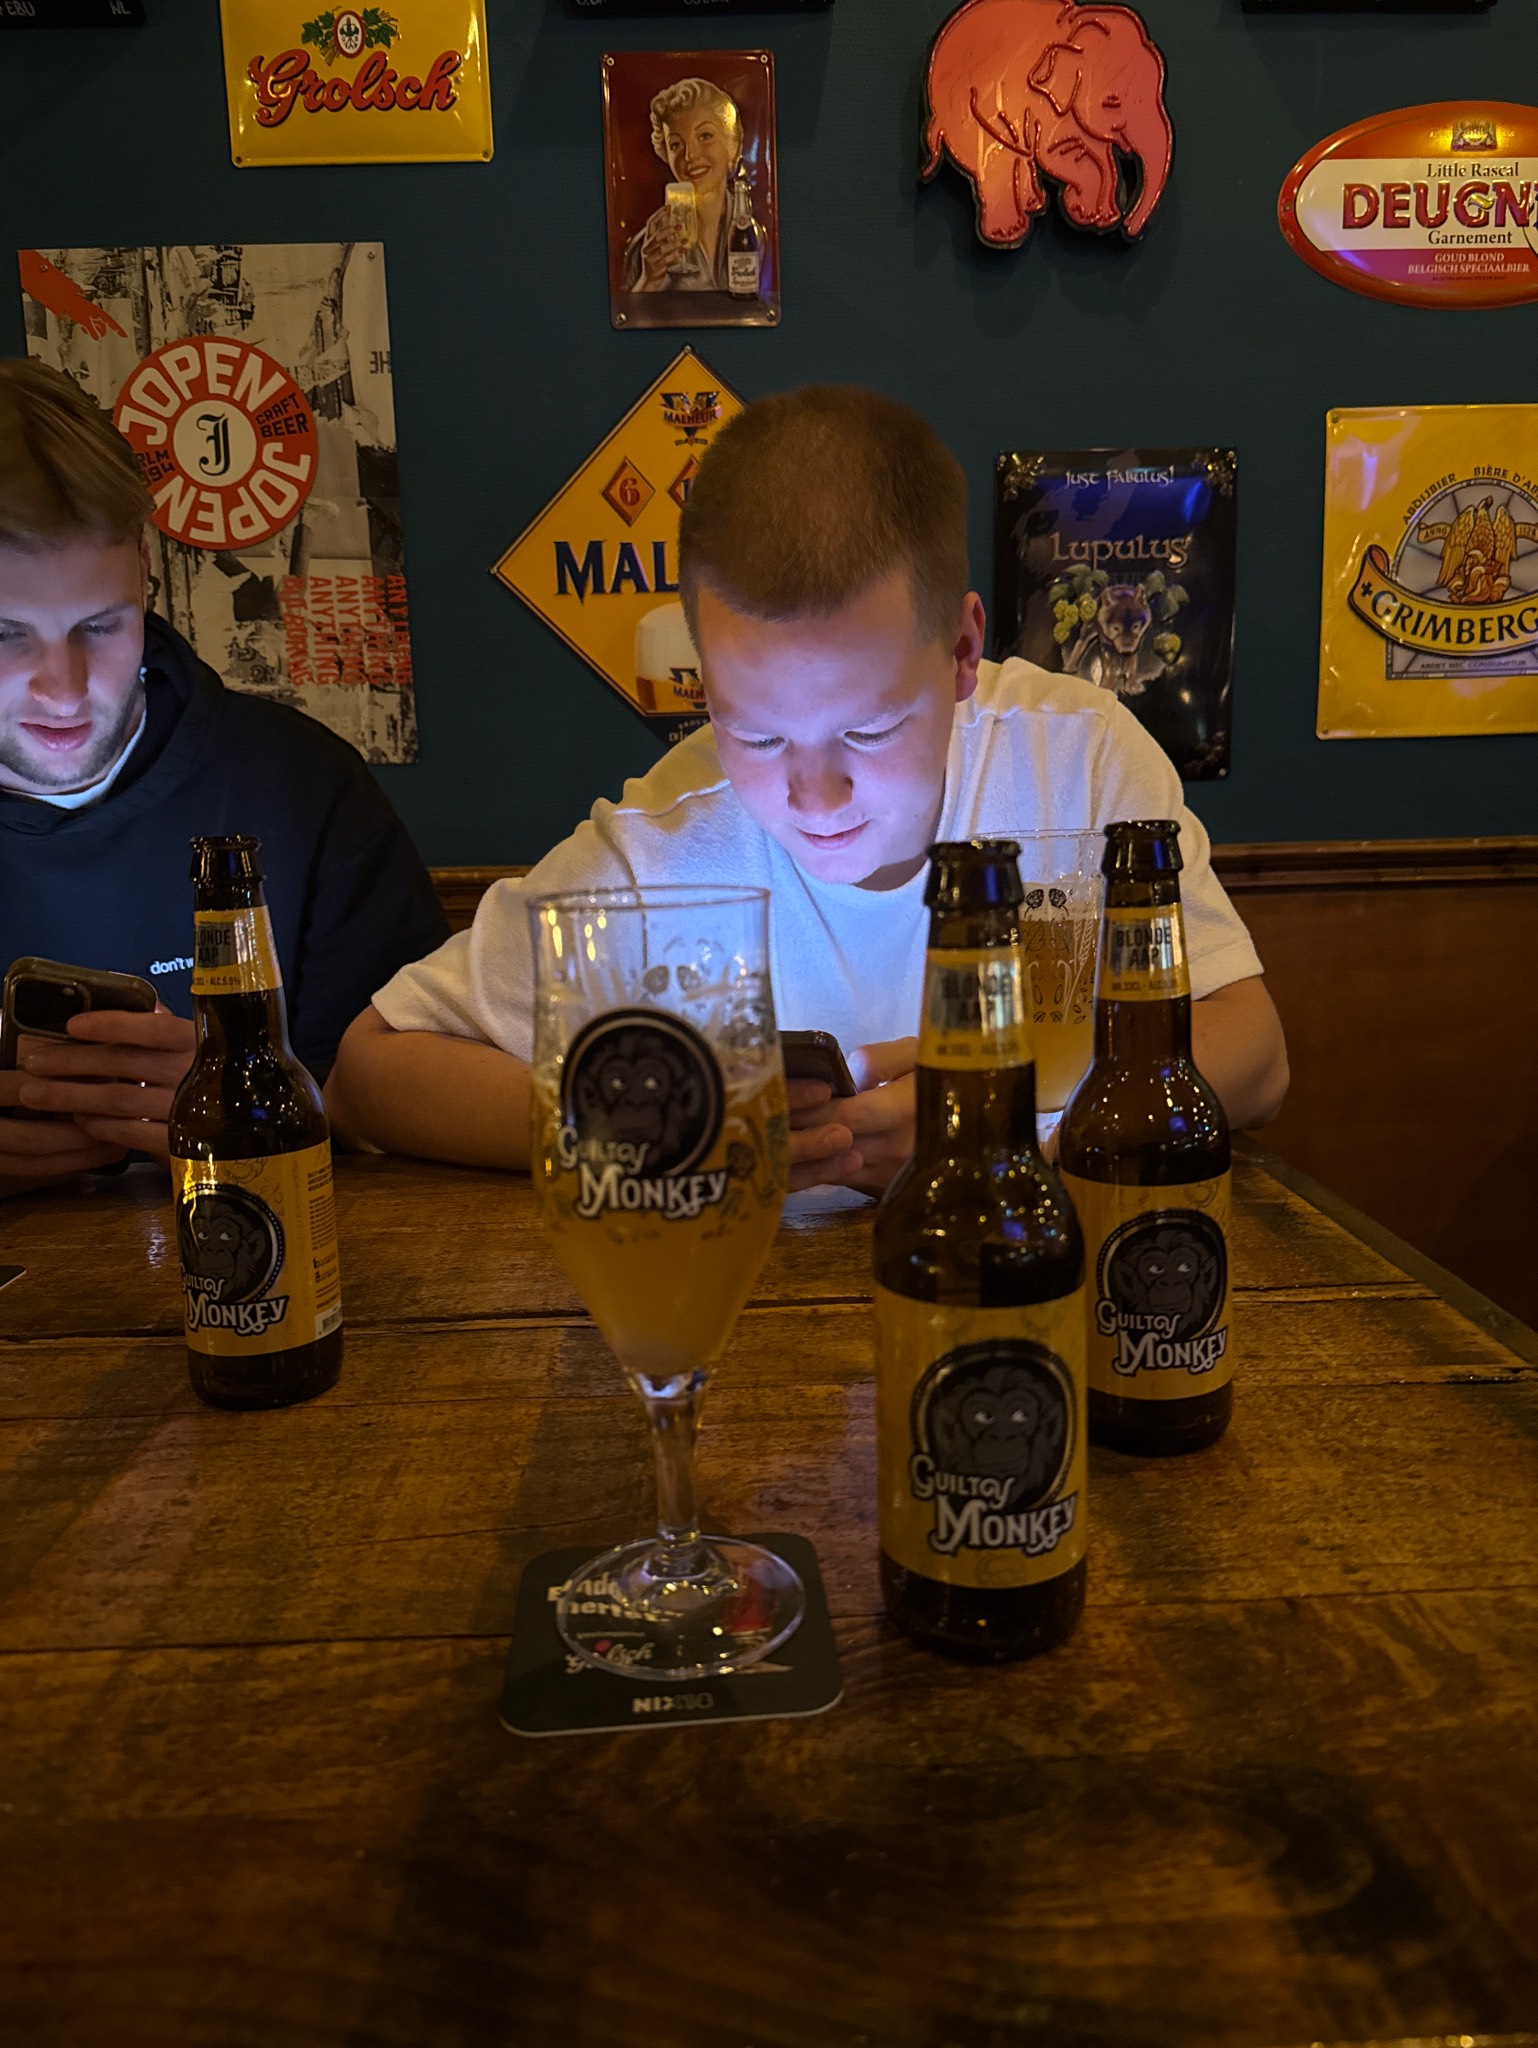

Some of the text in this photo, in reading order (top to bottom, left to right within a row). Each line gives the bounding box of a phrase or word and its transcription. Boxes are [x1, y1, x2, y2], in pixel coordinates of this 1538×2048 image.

[248, 49, 461, 128] Grolsch
[1426, 162, 1520, 178] Little Rascal
[1342, 180, 1538, 229] DEUGN
[1427, 231, 1513, 245] Garnement
[1434, 251, 1505, 263] GOUD BLOND
[1408, 263, 1530, 274] BELGISCH SPECIAALBIER
[119, 341, 287, 446] JOPEN
[255, 392, 300, 425] CRAFT
[260, 412, 309, 438] BEER
[663, 409, 717, 425] MALHEUR
[1473, 464, 1509, 479] BIÈRE
[154, 441, 312, 544] JOPEN
[618, 478, 641, 507] 6
[1402, 473, 1457, 525] ABDIJBIER
[309, 576, 341, 686] ANYTHING
[335, 576, 366, 685] ANYTHING
[361, 575, 393, 685] ANYTHING
[1115, 927, 1172, 948] BLONDE
[1128, 946, 1160, 966] AAP
[150, 957, 185, 975] don't
[577, 1162, 728, 1219] MONKEY
[187, 1289, 288, 1333] MONKEY
[1114, 1330, 1228, 1374] MONKEY
[930, 1495, 1077, 1554] MONKEY
